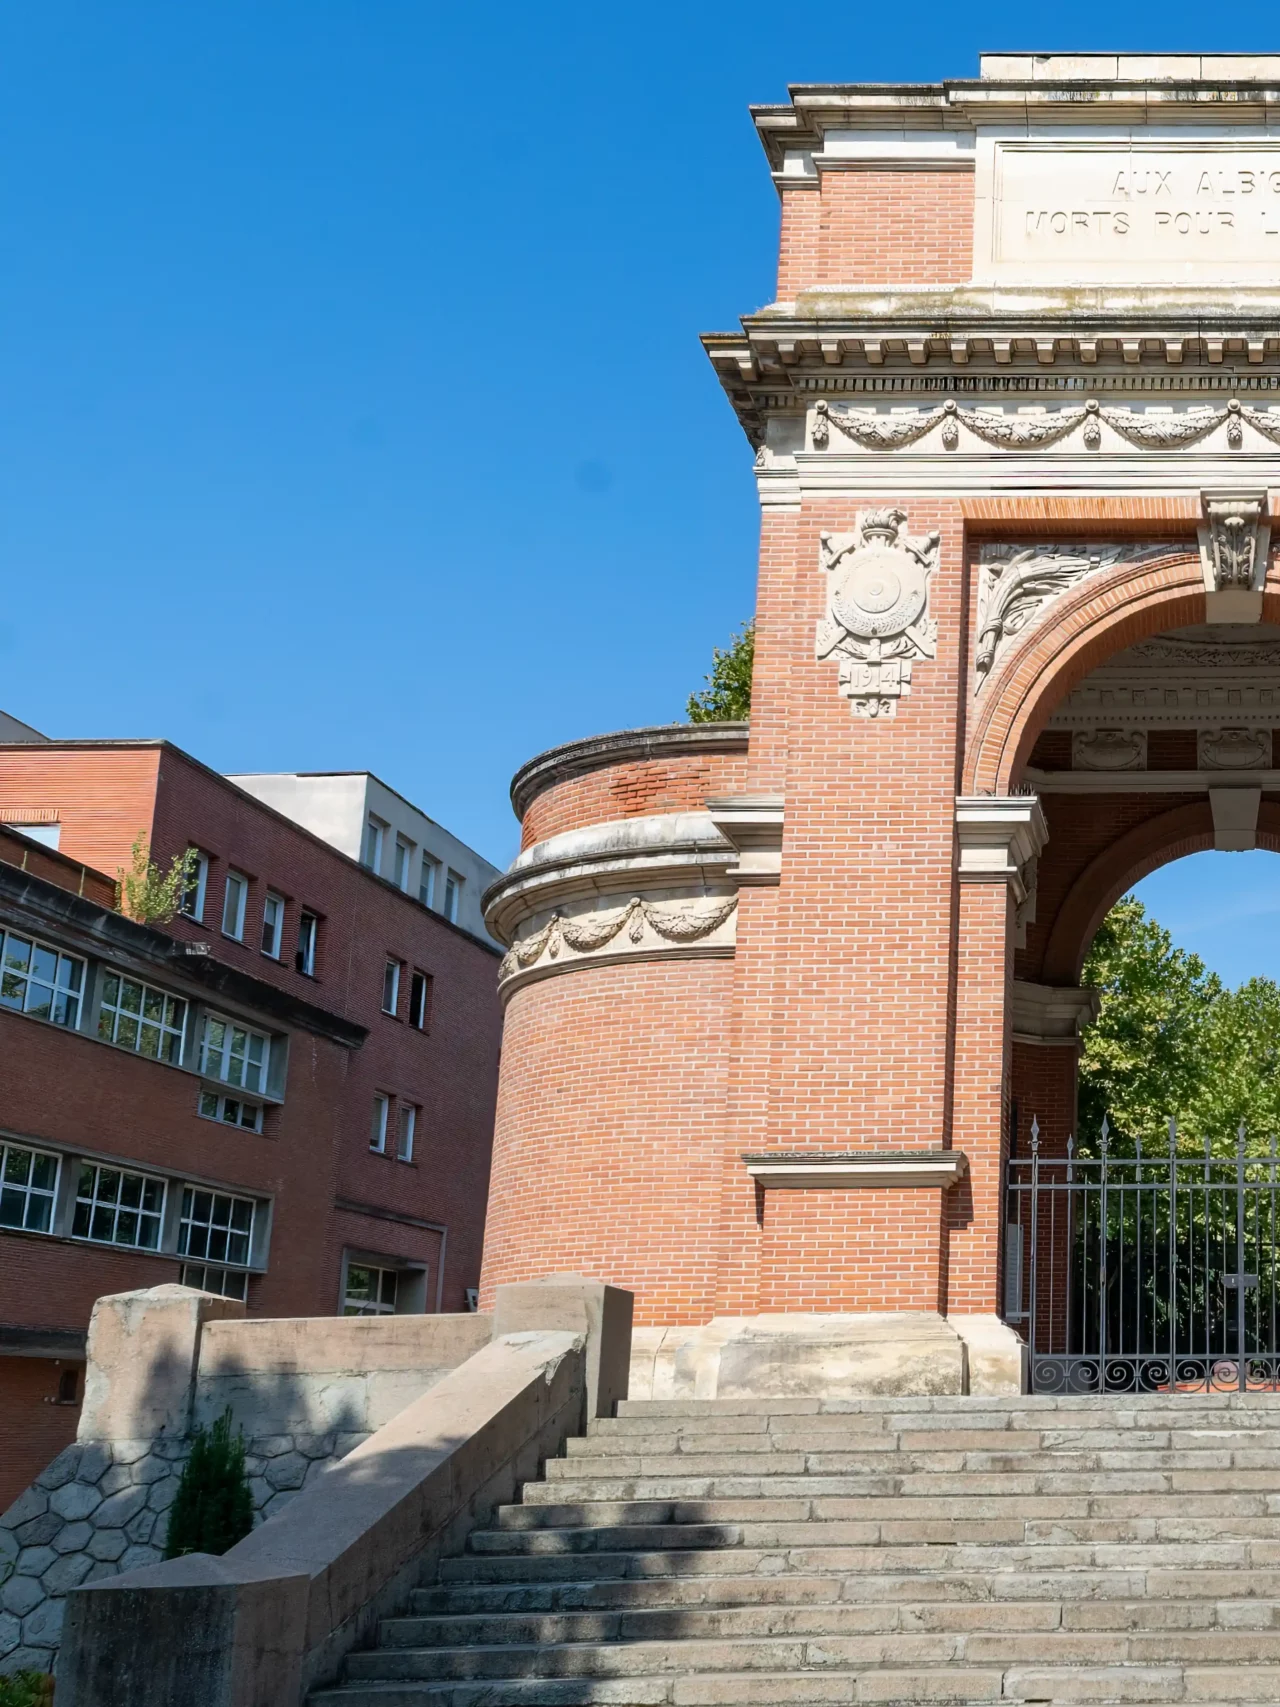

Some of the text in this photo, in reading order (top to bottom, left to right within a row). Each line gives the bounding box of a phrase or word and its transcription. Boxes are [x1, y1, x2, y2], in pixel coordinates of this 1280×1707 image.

[1111, 170, 1172, 195] AUX
[1025, 211, 1132, 236] MORTS
[1153, 211, 1236, 236] POUR
[853, 667, 896, 688] 1914
